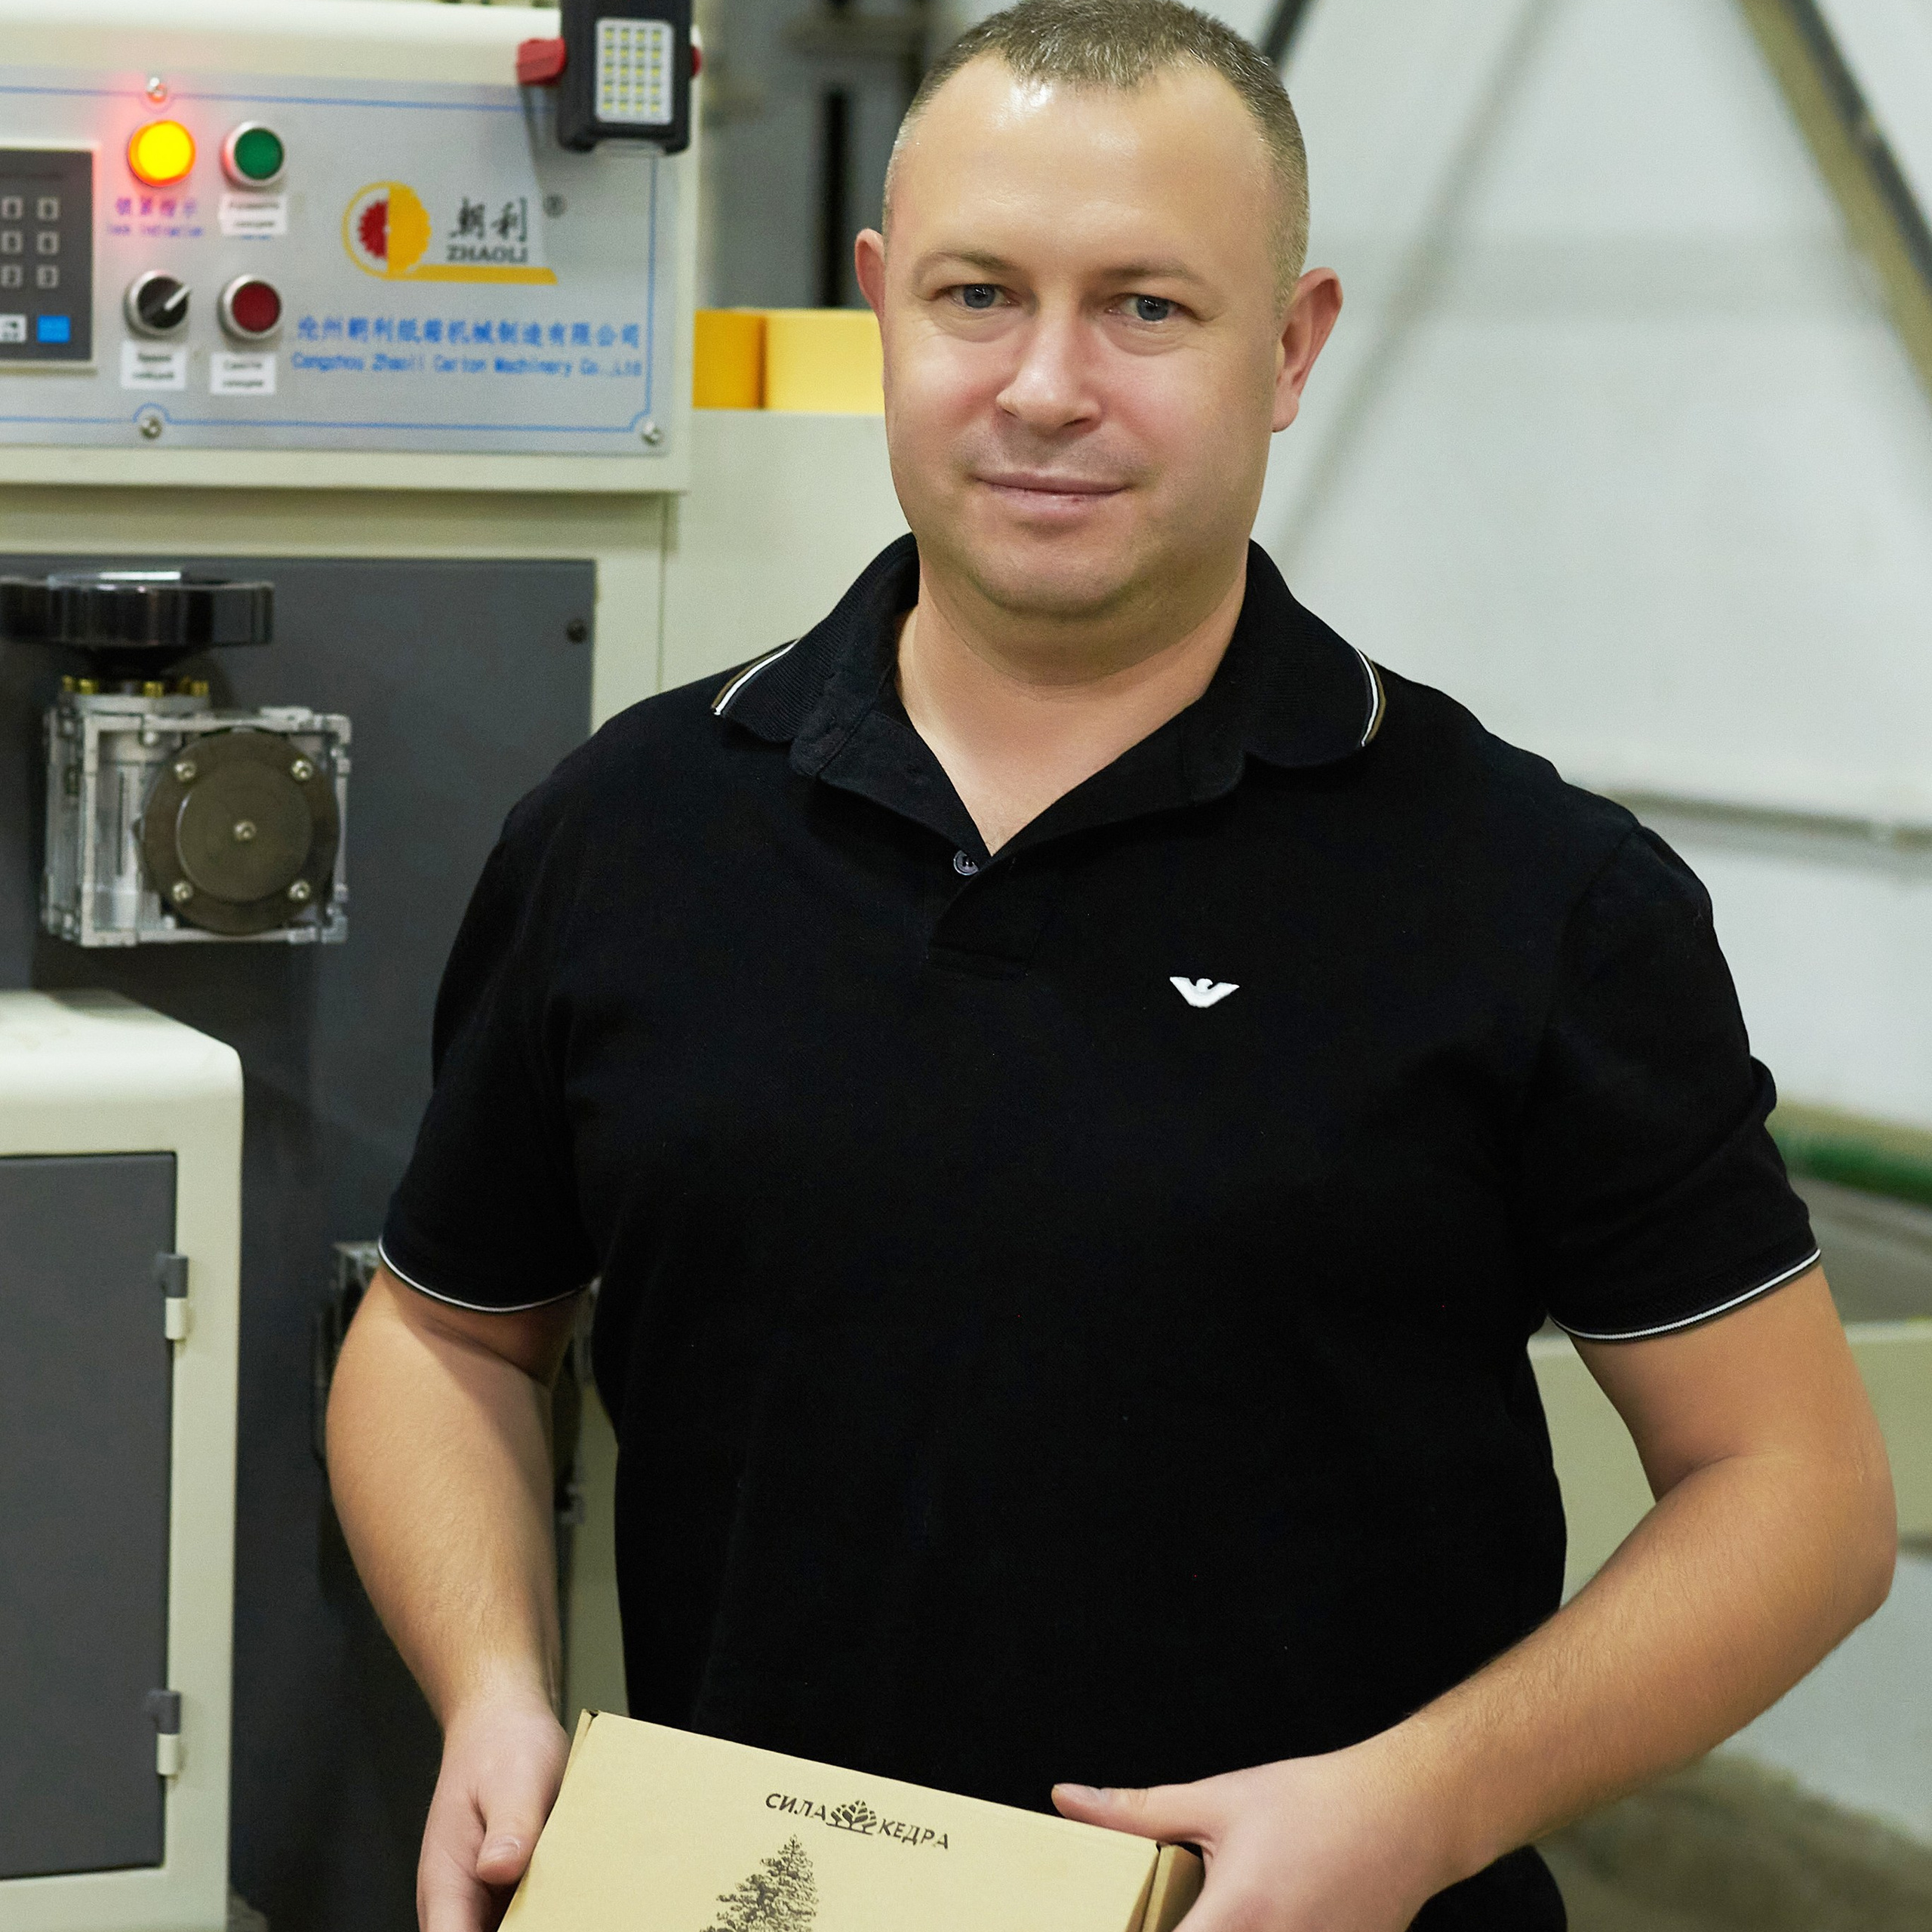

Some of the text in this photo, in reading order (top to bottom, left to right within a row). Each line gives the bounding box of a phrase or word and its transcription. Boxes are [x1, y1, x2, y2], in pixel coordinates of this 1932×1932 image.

[446, 245, 528, 263] ZHAOLI
[765, 1793, 949, 1850] СИЛА КЕДРА
